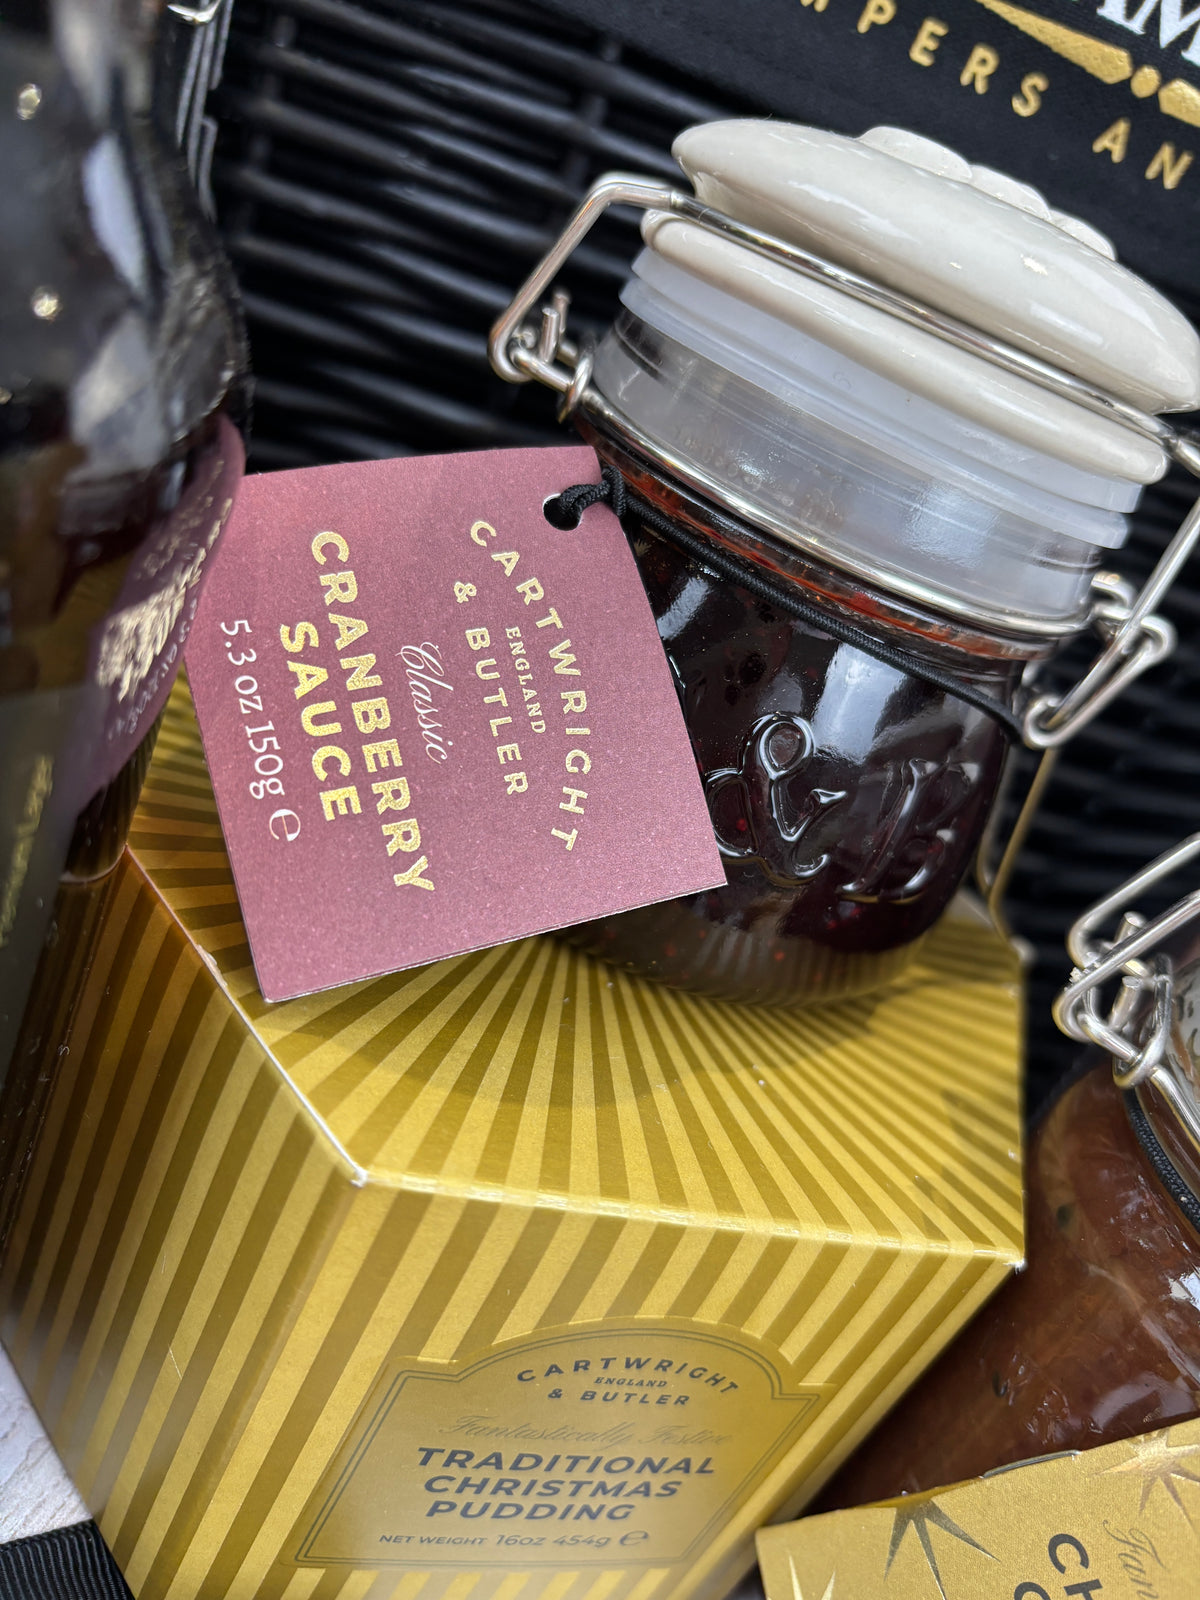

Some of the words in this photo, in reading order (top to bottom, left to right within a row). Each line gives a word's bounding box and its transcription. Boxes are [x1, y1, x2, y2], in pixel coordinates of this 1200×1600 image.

[800, 0, 1049, 118] PERS
[453, 580, 478, 605] &
[219, 619, 258, 666] 5.3
[234, 675, 264, 715] oz
[470, 519, 593, 852] CARTWRIGHT
[504, 626, 548, 735] ENGLAND
[279, 621, 363, 822] SAUCE
[310, 530, 436, 892] CRANBERRY
[395, 641, 455, 765] Classic
[464, 626, 529, 796] BUTLER
[244, 720, 286, 800] 150g
[516, 1356, 740, 1394] CARTWRIGHT
[594, 1376, 669, 1389] ENGLAND
[547, 1388, 564, 1400] &
[580, 1390, 691, 1406] BUTLER
[438, 1414, 637, 1450] Fantastically
[417, 1447, 716, 1475] TRADITIONAL
[423, 1475, 683, 1498] CHRISTMAS
[425, 1500, 636, 1521] PUDDING
[378, 1535, 416, 1544] NET
[419, 1536, 488, 1546] WEIGHT
[494, 1534, 546, 1547] 16oz
[552, 1534, 612, 1549] 454g
